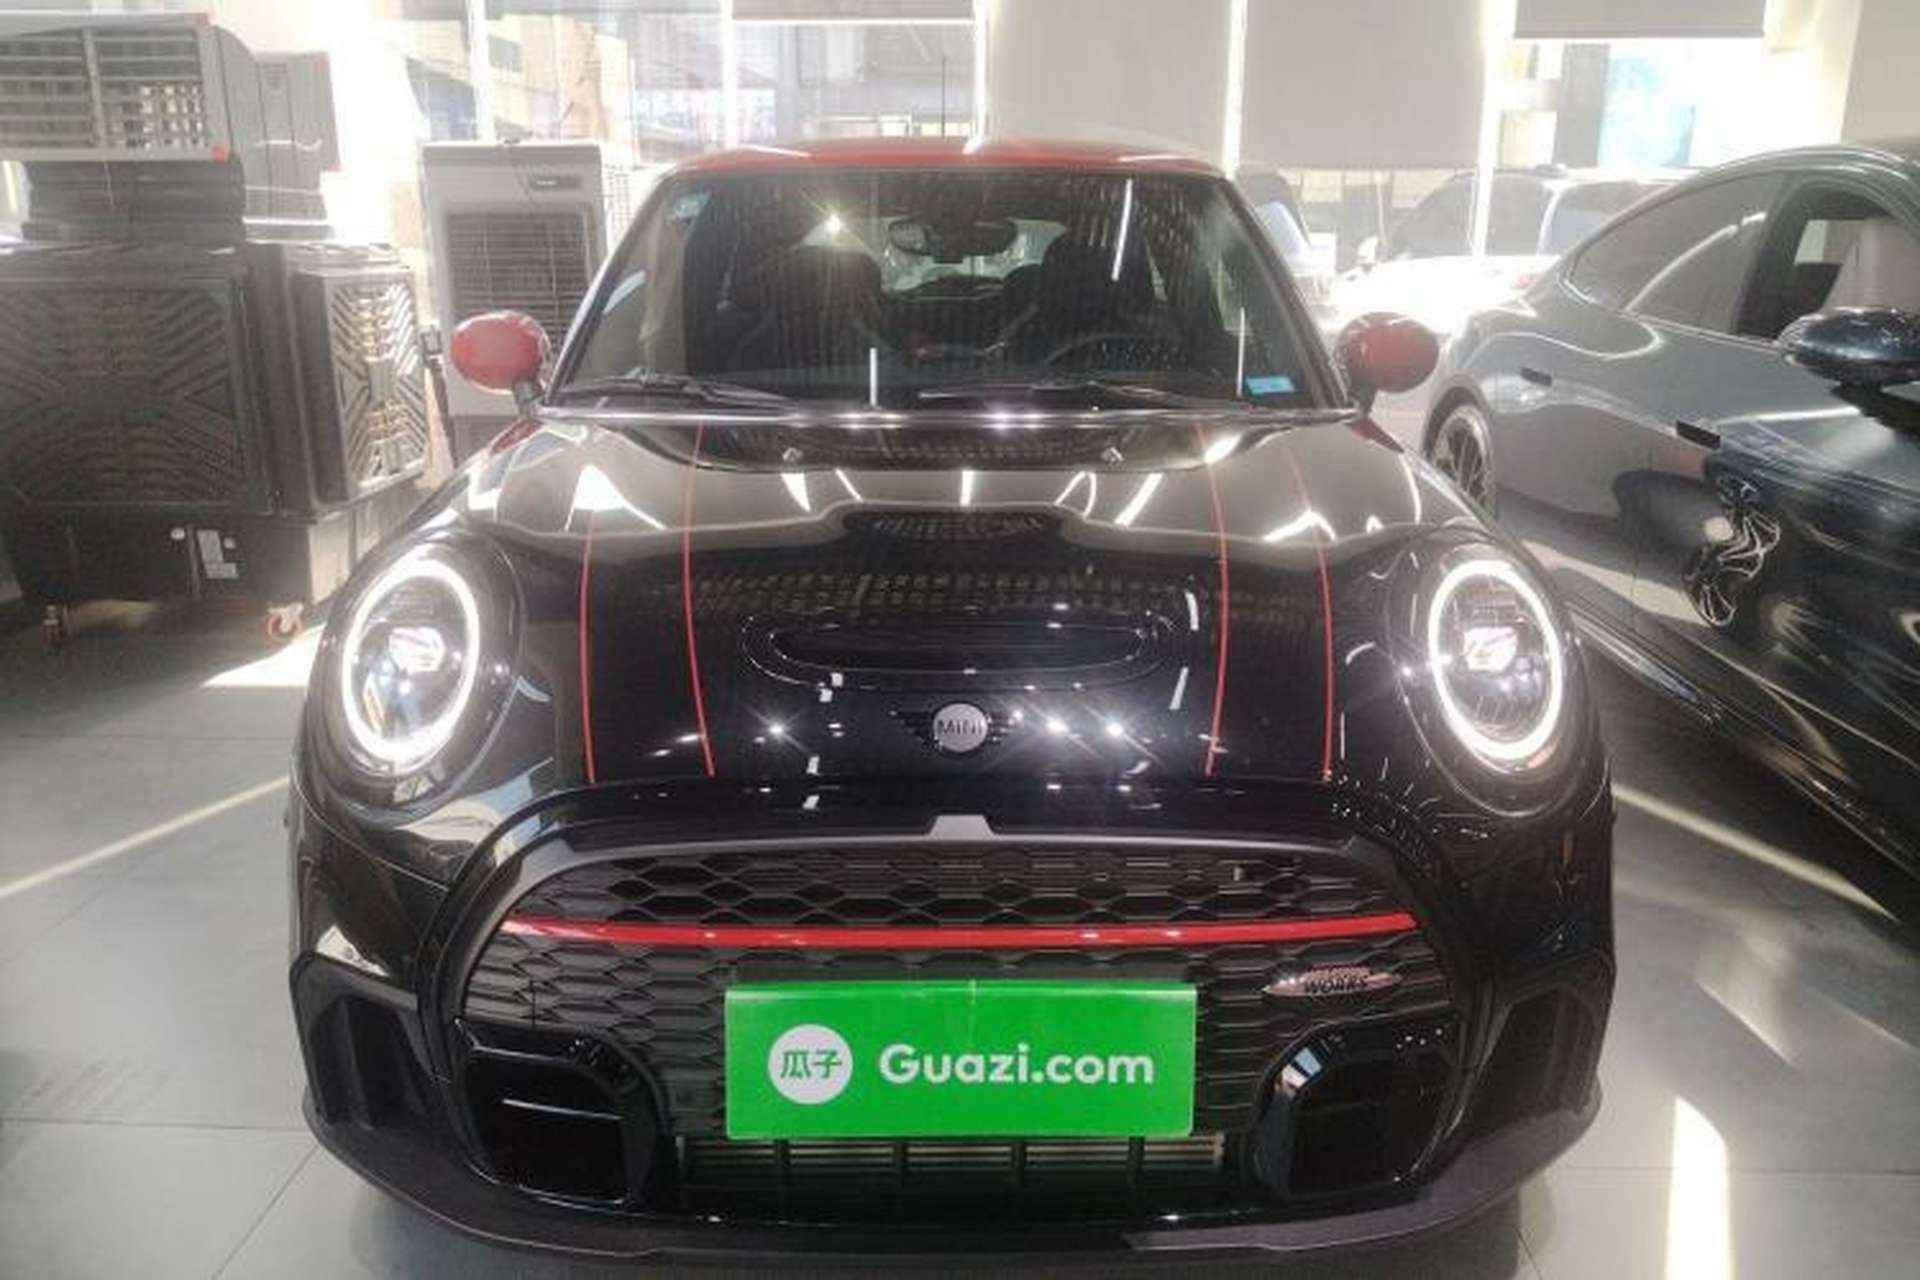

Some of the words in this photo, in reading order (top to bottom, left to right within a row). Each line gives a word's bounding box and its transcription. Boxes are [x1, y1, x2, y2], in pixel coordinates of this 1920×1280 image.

[937, 720, 982, 734] MINI
[779, 1048, 842, 1080] 瓜子
[879, 1042, 1155, 1085] Guazi.com
